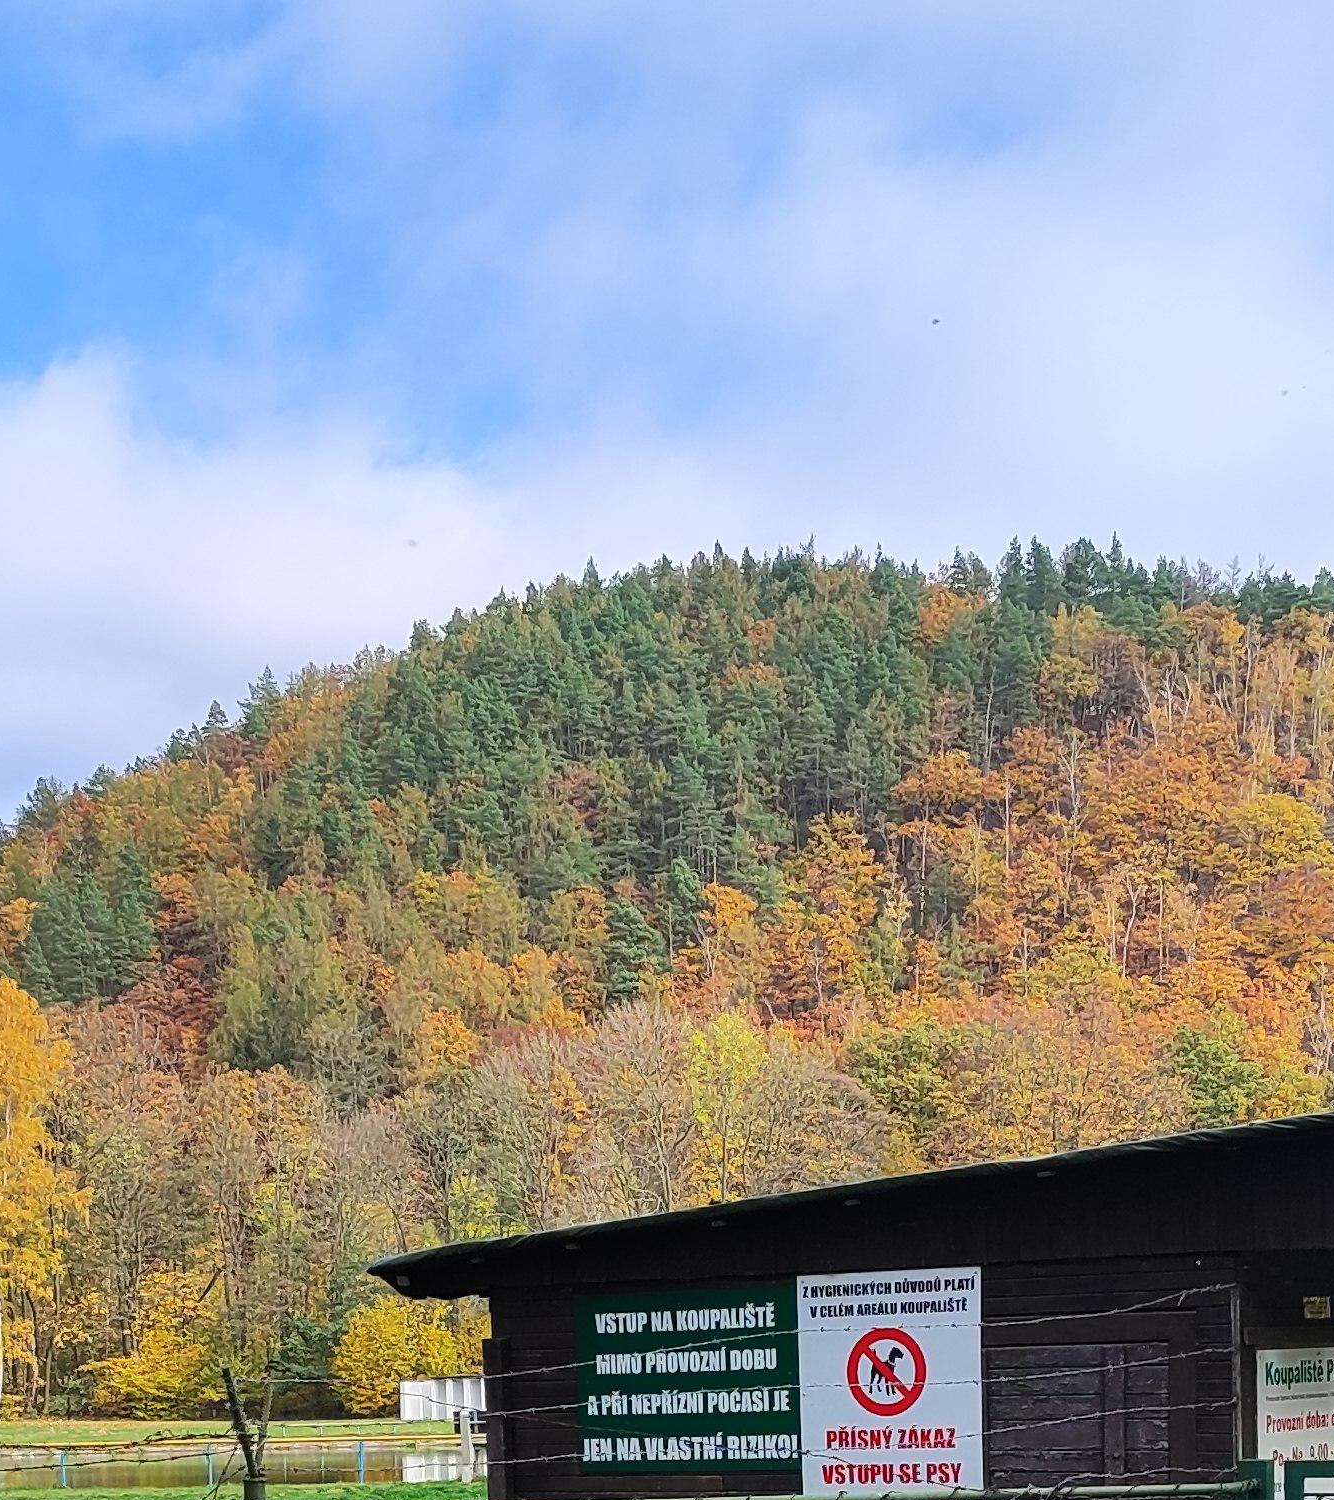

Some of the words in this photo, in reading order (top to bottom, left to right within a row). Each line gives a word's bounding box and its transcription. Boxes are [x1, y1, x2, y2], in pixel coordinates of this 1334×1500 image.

[803, 1286, 809, 1298] Z
[811, 1281, 892, 1298] HYGIENICKÝCH
[895, 1276, 940, 1293] DŮVODŮ
[944, 1275, 975, 1291] PLATÍ
[595, 1313, 647, 1334] VSTUP
[651, 1311, 673, 1332] NA
[676, 1302, 775, 1331] KOUPALIŠTĚ
[810, 1306, 817, 1318] V
[820, 1303, 854, 1317] CELÉM
[857, 1301, 897, 1316] AREÁLU
[901, 1297, 968, 1314] KOUPALIŠTĚ
[596, 1354, 642, 1375] MIMO
[646, 1347, 726, 1374] PROVOZNÍ
[730, 1348, 777, 1371] DOBU
[1265, 1359, 1323, 1390] Koupaliště
[587, 1395, 599, 1415] A
[601, 1391, 627, 1415] PŘI
[773, 1390, 791, 1411] JE
[1266, 1411, 1304, 1434] Provozní
[1306, 1410, 1329, 1429] doba:
[583, 1438, 612, 1462] JEN
[617, 1438, 641, 1461] NA
[644, 1432, 723, 1461] VLASTNÍ
[727, 1434, 798, 1460] RIZIKO!
[826, 1425, 892, 1449] PŘÍSNÝ
[897, 1425, 956, 1449] ZÁKAZ
[822, 1464, 894, 1484] VSTUPU
[899, 1463, 923, 1484] SE
[927, 1463, 962, 1484] PSY
